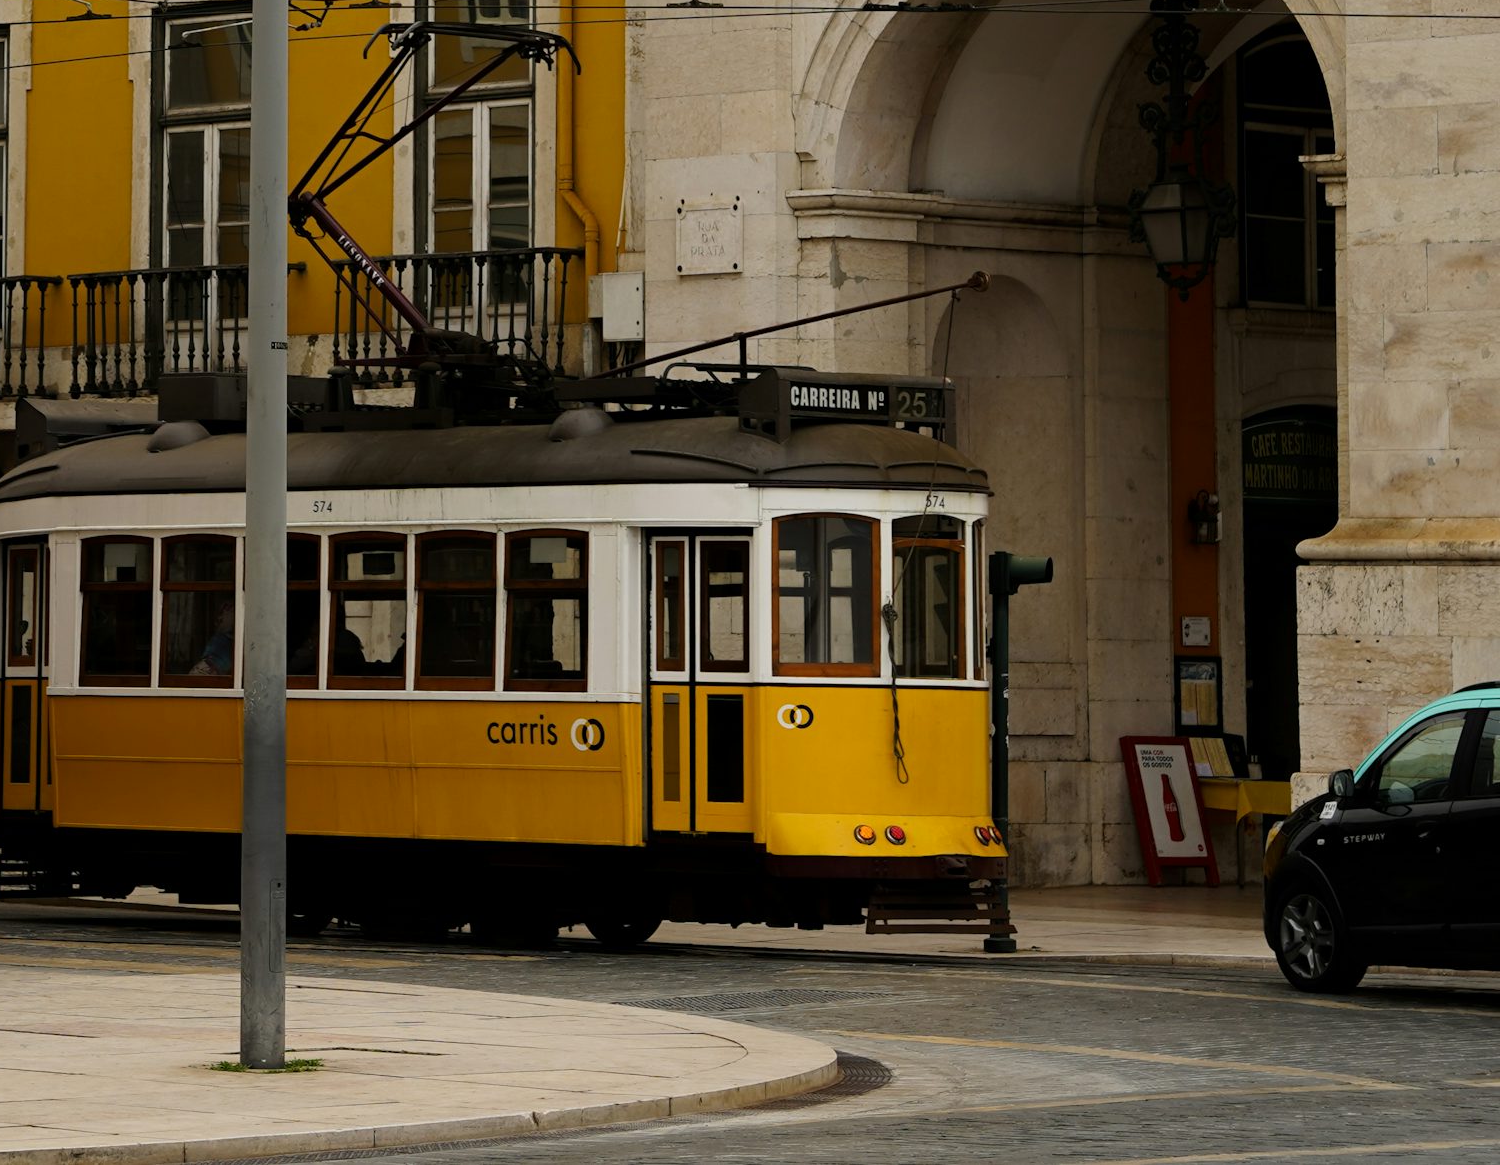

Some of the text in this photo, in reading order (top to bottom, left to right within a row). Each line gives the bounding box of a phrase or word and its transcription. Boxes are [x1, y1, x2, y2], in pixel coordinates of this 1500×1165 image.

[698, 221, 720, 232] RUA
[701, 233, 716, 244] DA
[690, 245, 726, 258] PRATA
[337, 234, 385, 288] LUSONAVE
[790, 385, 860, 410] CARREIRA
[897, 391, 928, 419] 25
[1244, 463, 1298, 490] MARTINHO
[313, 501, 333, 513] 574
[925, 495, 945, 509] 574
[487, 714, 558, 746] carris
[1151, 761, 1173, 769] GOSTOS
[1343, 833, 1386, 844] STEPWAY
